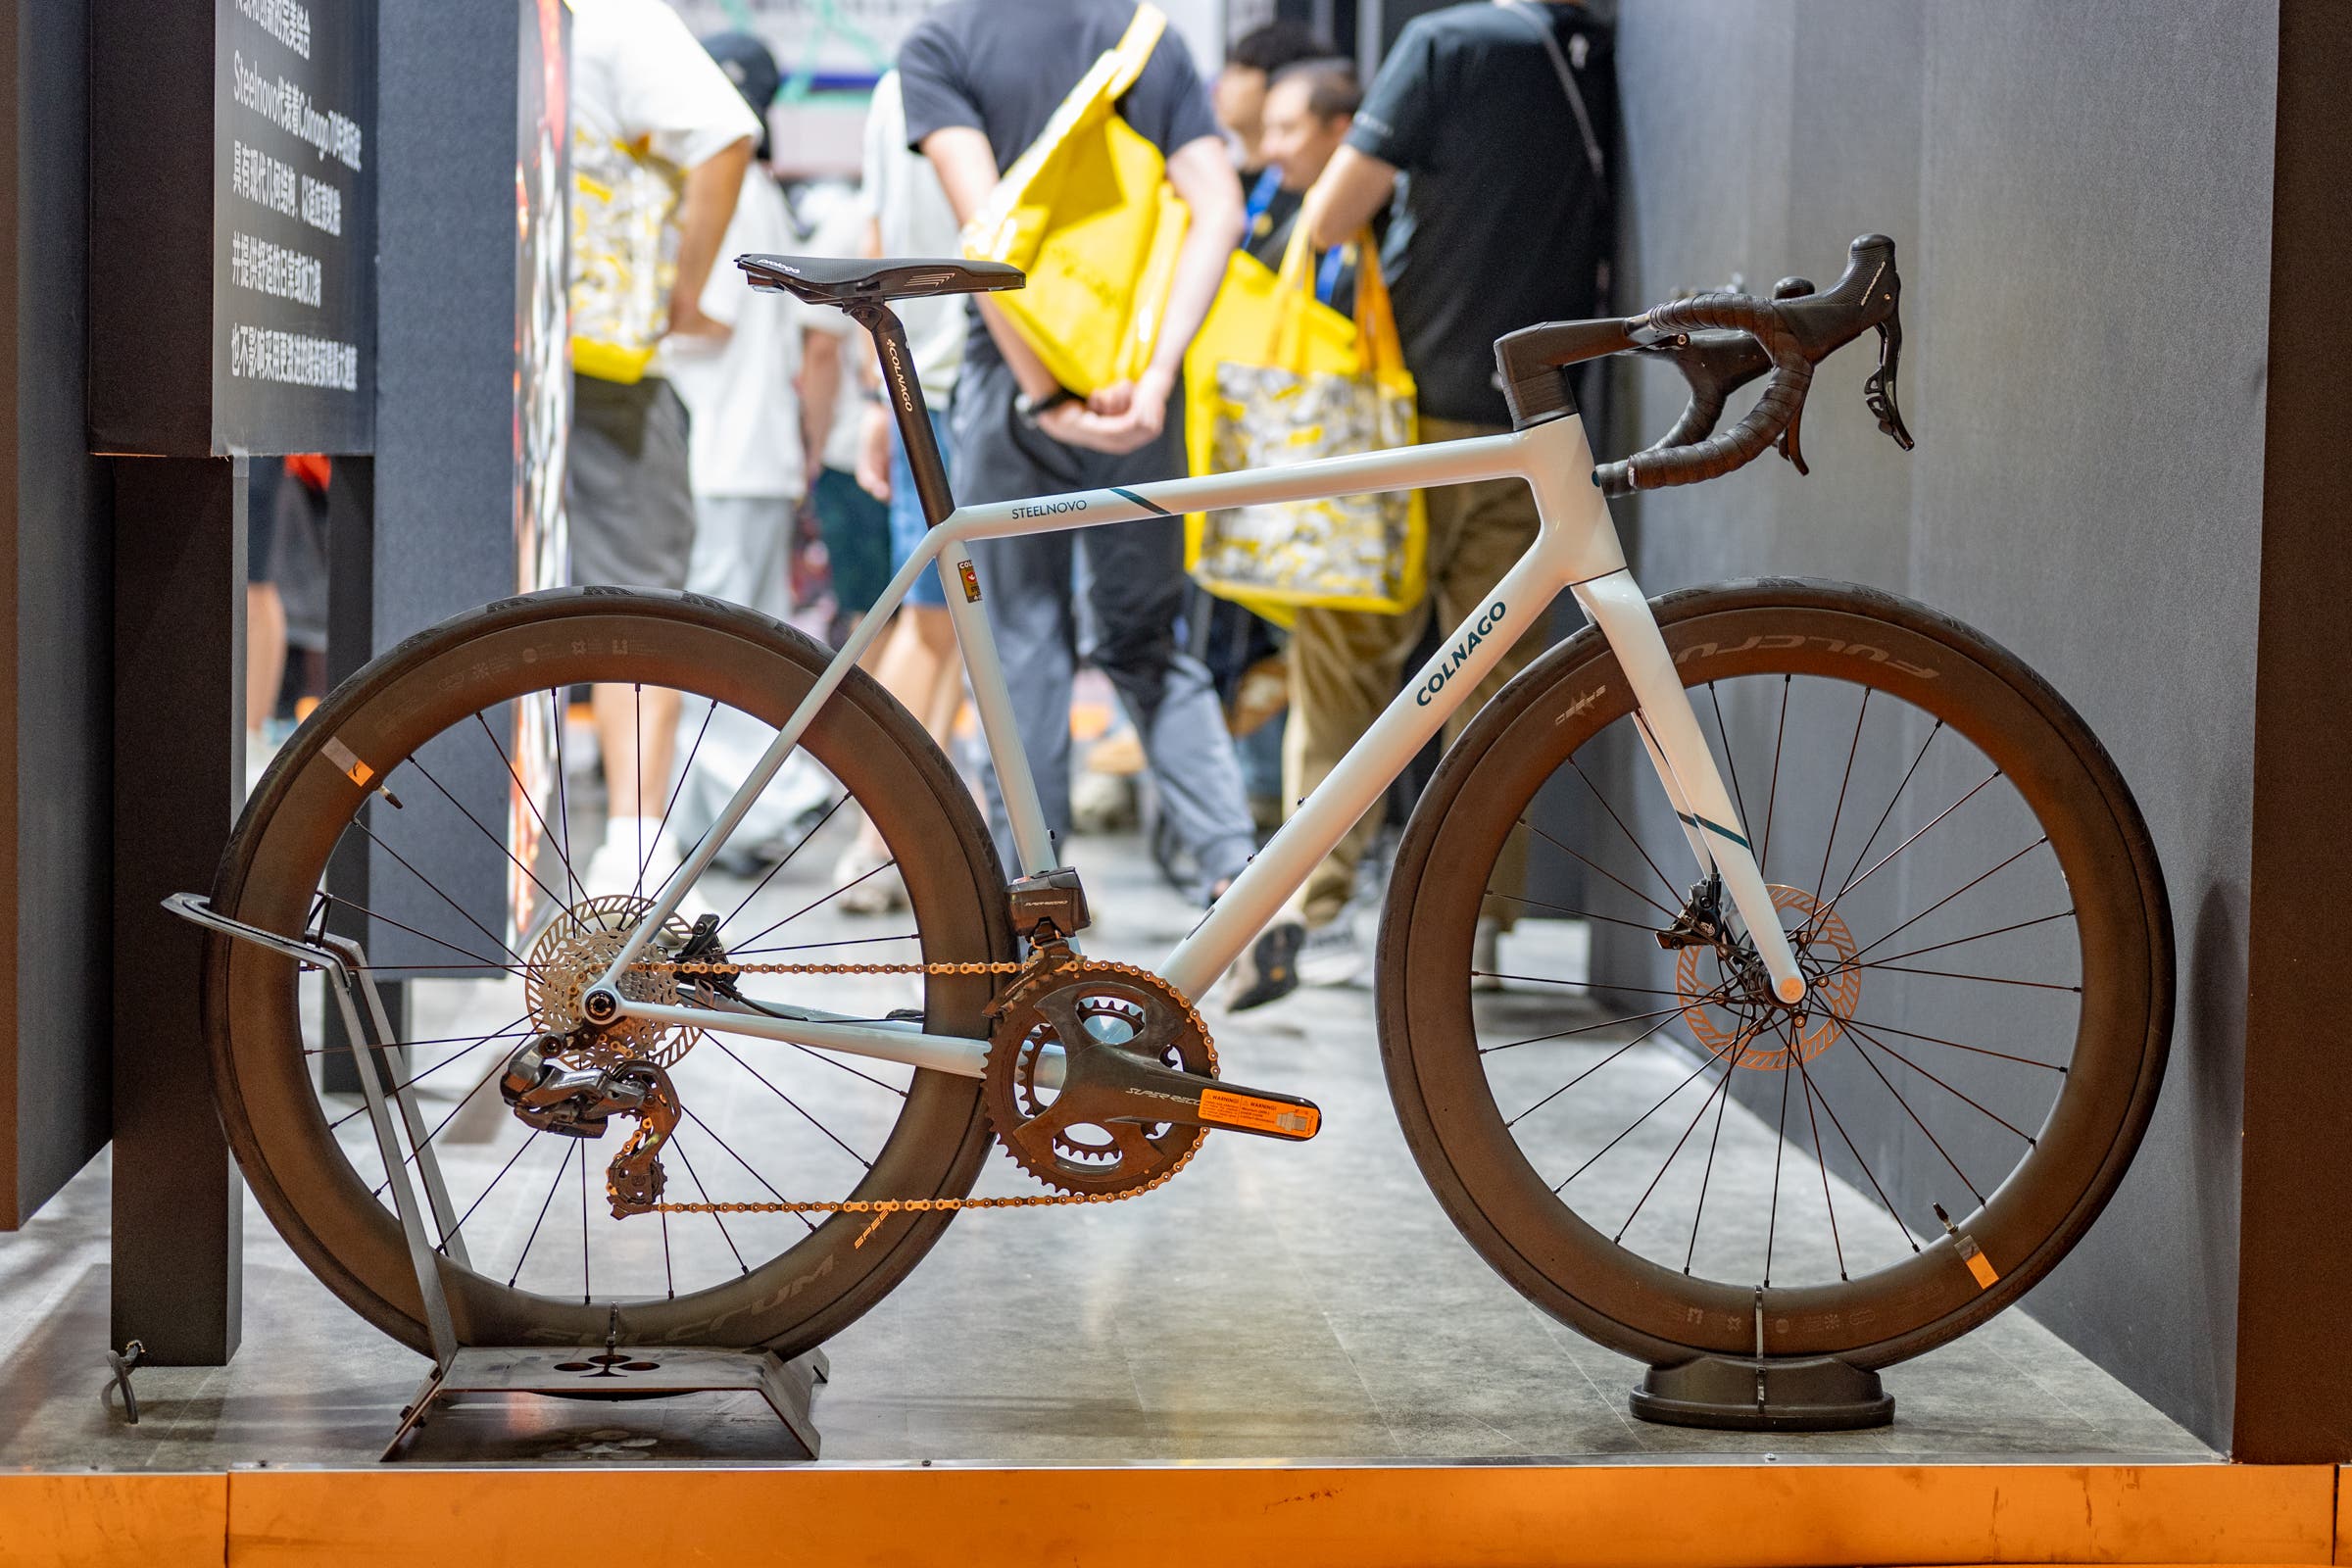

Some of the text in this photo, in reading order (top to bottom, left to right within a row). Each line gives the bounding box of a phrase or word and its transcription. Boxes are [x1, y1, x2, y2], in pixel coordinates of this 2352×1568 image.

[888, 346, 913, 414] COLNAGO
[1011, 499, 1088, 520] STEELNOVO
[1415, 600, 1506, 708] COLNAGO
[1673, 634, 1940, 679] FULCRU
[1125, 1087, 1171, 1100] SUPER
[854, 1205, 892, 1250] SPEE
